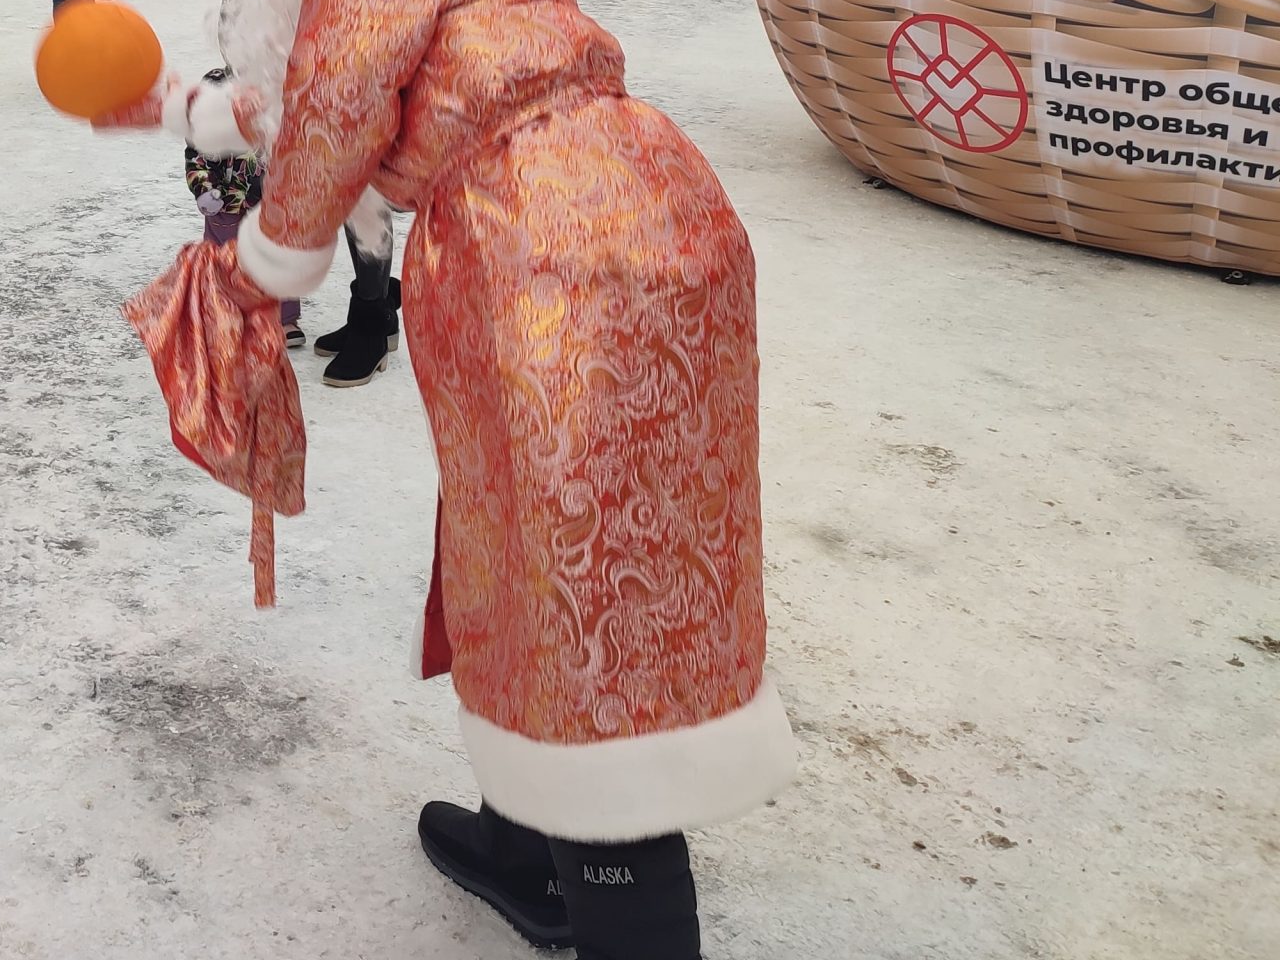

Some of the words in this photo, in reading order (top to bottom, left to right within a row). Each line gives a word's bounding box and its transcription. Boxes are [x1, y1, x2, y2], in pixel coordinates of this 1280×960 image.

[1044, 61, 1166, 101] Центр
[1046, 100, 1229, 140] здоровья
[1243, 127, 1269, 147] и
[1049, 132, 1280, 182] профилакти
[583, 863, 635, 885] ALASKA
